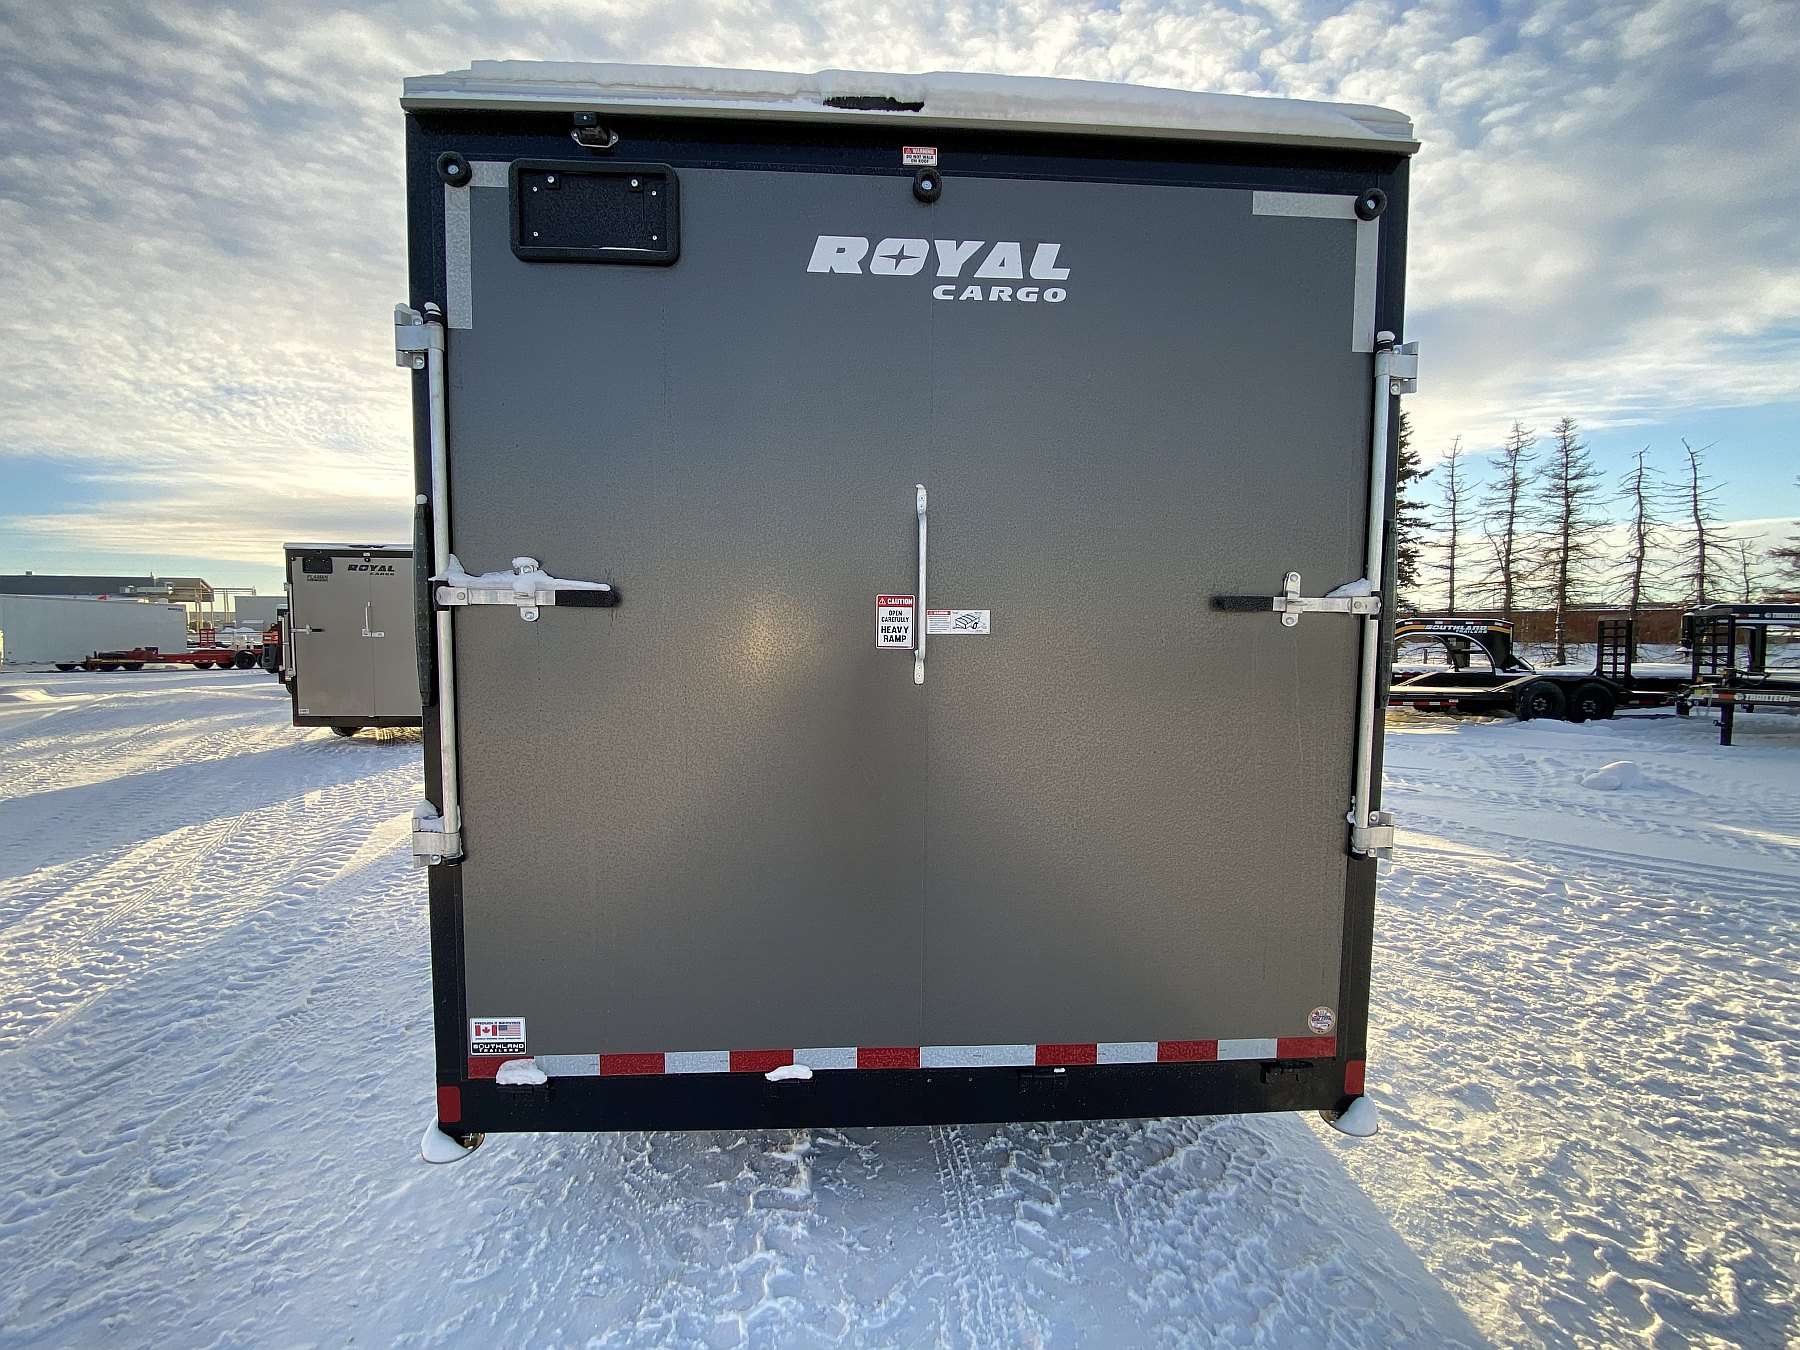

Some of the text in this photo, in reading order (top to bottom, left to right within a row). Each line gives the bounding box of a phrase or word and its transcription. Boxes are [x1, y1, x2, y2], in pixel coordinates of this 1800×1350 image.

[806, 235, 1071, 280] ROYAL
[932, 284, 1067, 303] CARGO
[347, 564, 395, 572] ROYAL
[880, 625, 909, 634] HEAVY
[883, 634, 907, 643] RAMP
